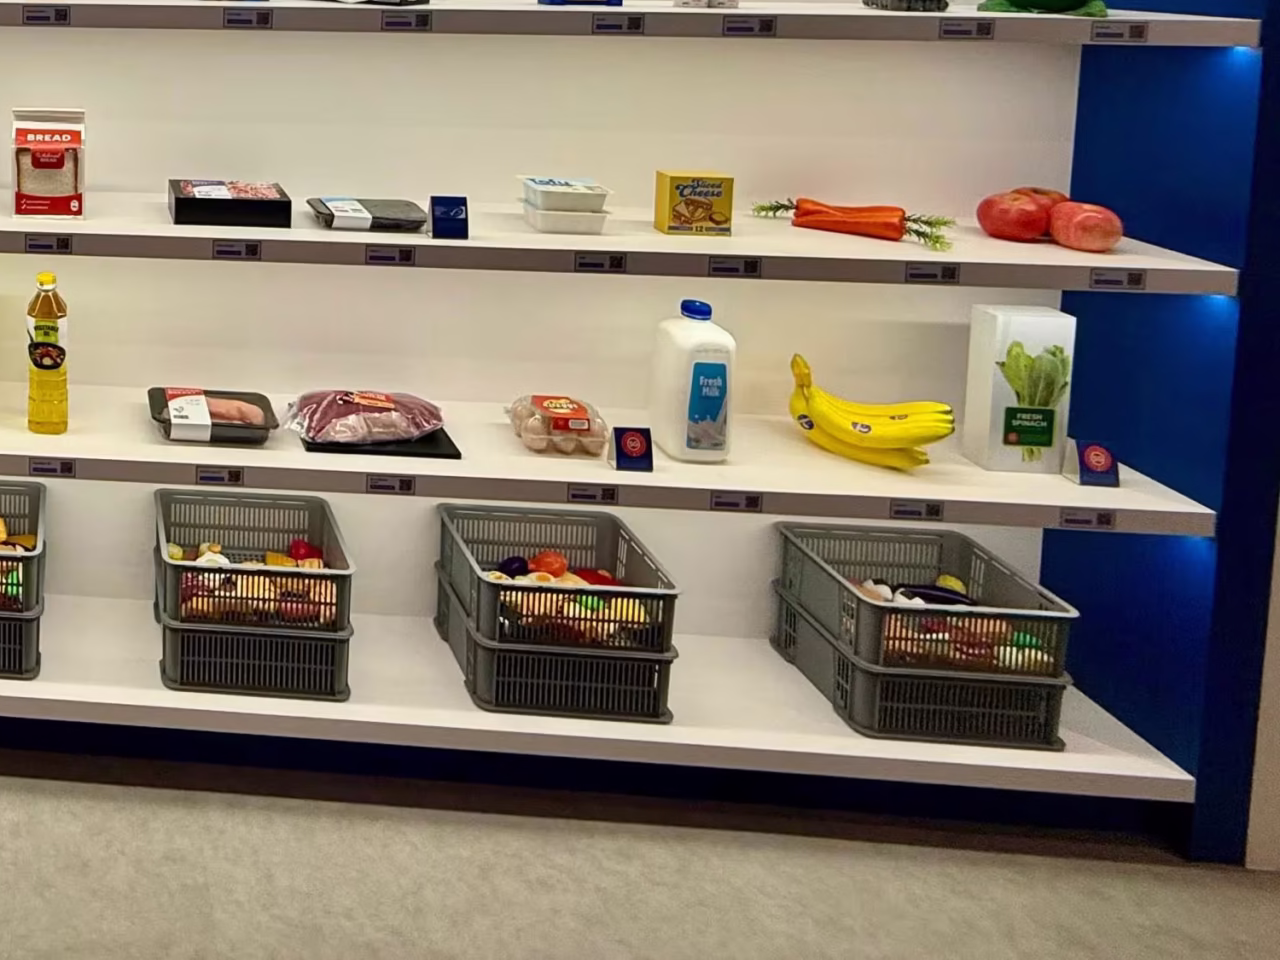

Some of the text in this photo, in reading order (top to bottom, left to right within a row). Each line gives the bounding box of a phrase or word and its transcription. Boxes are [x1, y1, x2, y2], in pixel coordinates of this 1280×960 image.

[26, 134, 72, 142] BREAD
[691, 178, 724, 189] Sliced
[675, 184, 723, 197] Cheese
[699, 376, 723, 387] Fresh
[701, 386, 721, 397] Milk
[1016, 413, 1043, 421] FRESH
[1011, 419, 1048, 428] SPINACH
